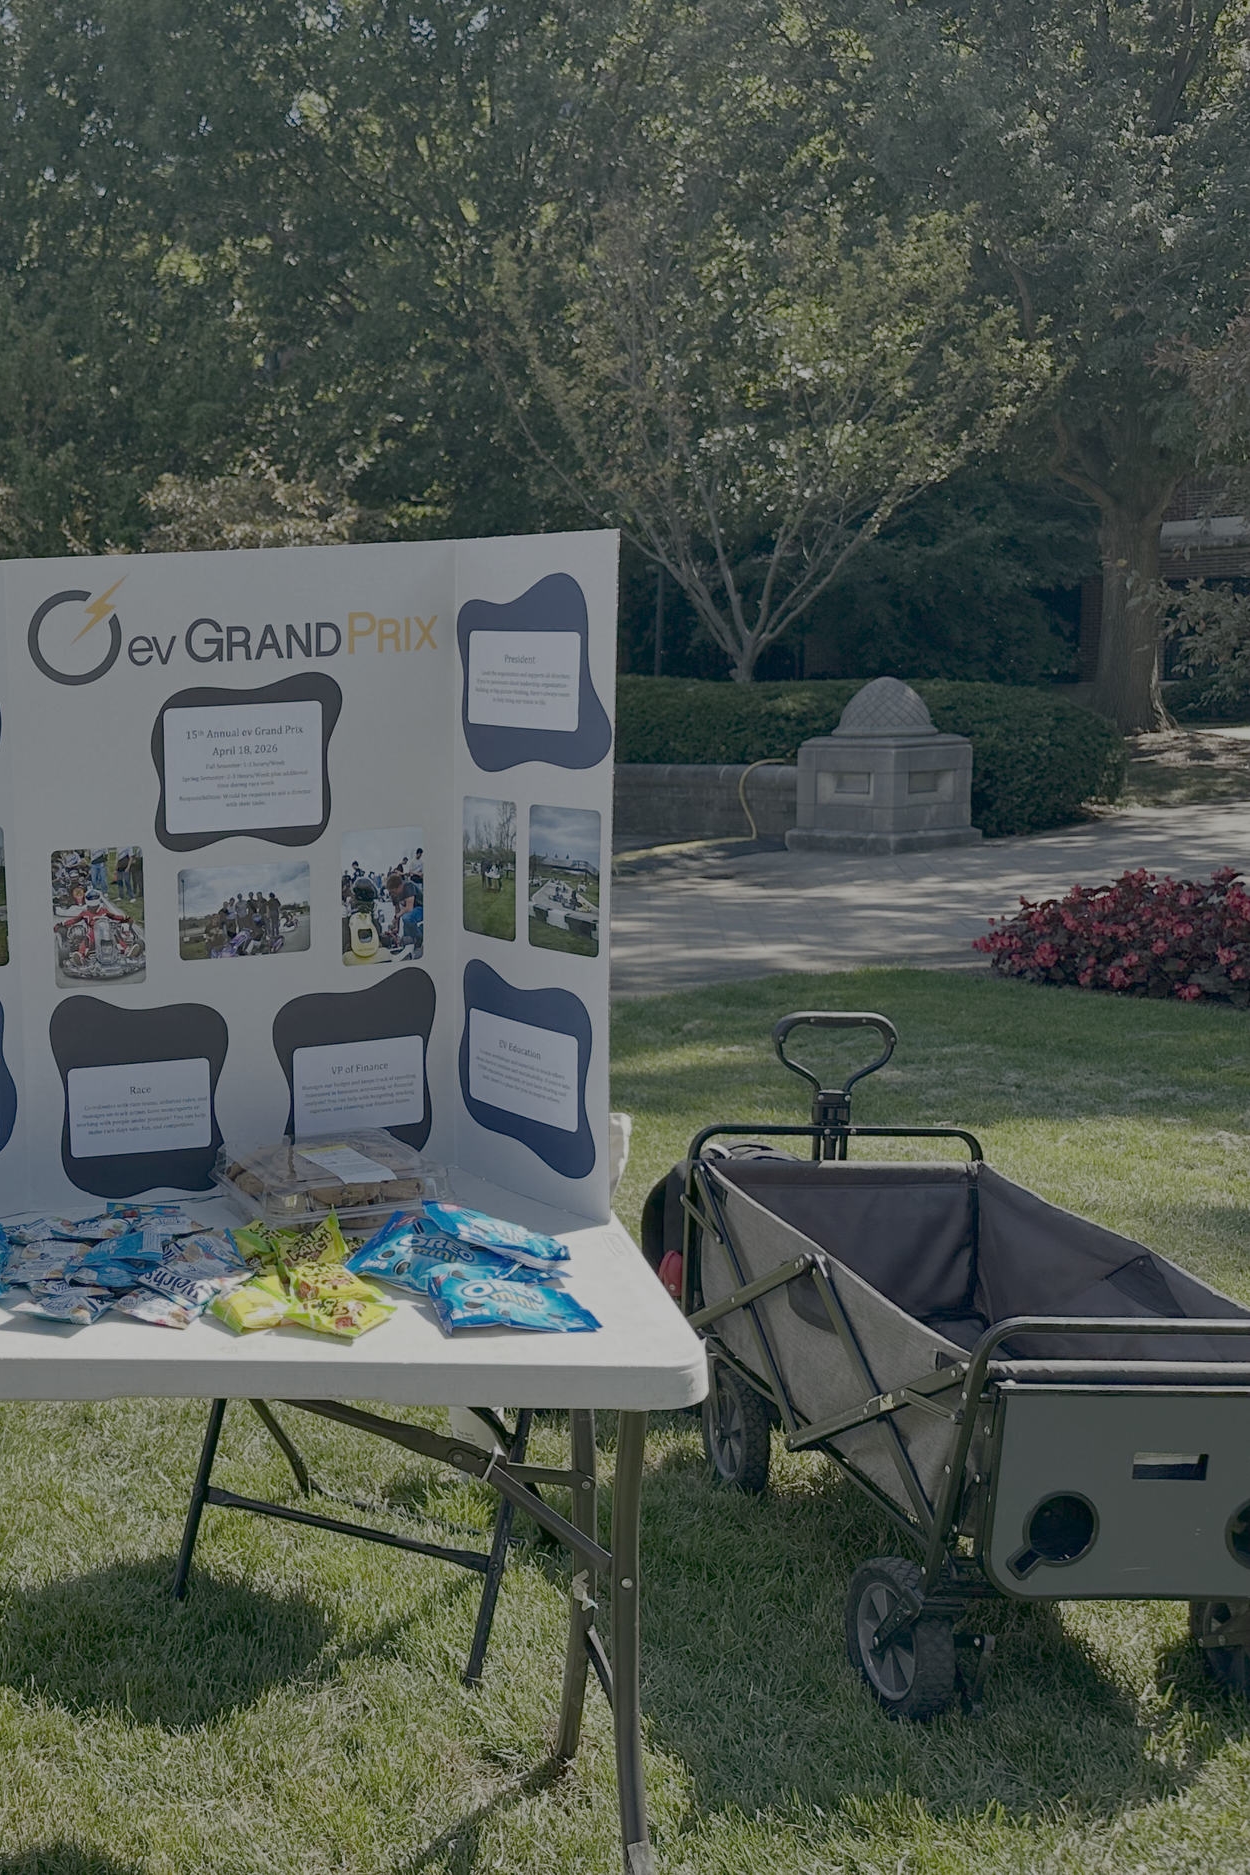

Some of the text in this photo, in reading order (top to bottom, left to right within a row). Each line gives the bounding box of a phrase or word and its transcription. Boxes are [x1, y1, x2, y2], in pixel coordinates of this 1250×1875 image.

[128, 612, 438, 666] ev GRAND PRIX
[504, 654, 535, 664] President
[186, 730, 204, 739] 15th
[206, 728, 239, 738] Annual
[255, 725, 282, 735] Grand
[285, 725, 303, 734] Prix
[212, 744, 278, 757] April 18, 2026
[499, 1039, 541, 1059] EV Education
[332, 1062, 388, 1075] VP of Finance
[130, 1086, 151, 1094] Race
[396, 1235, 475, 1262] OREO
[406, 1246, 457, 1264] mini
[302, 1263, 341, 1274] SOUR
[145, 1270, 204, 1299] Welch's
[306, 1271, 358, 1284] PATCH
[461, 1280, 545, 1305] OREO
[490, 1292, 540, 1312] mini
